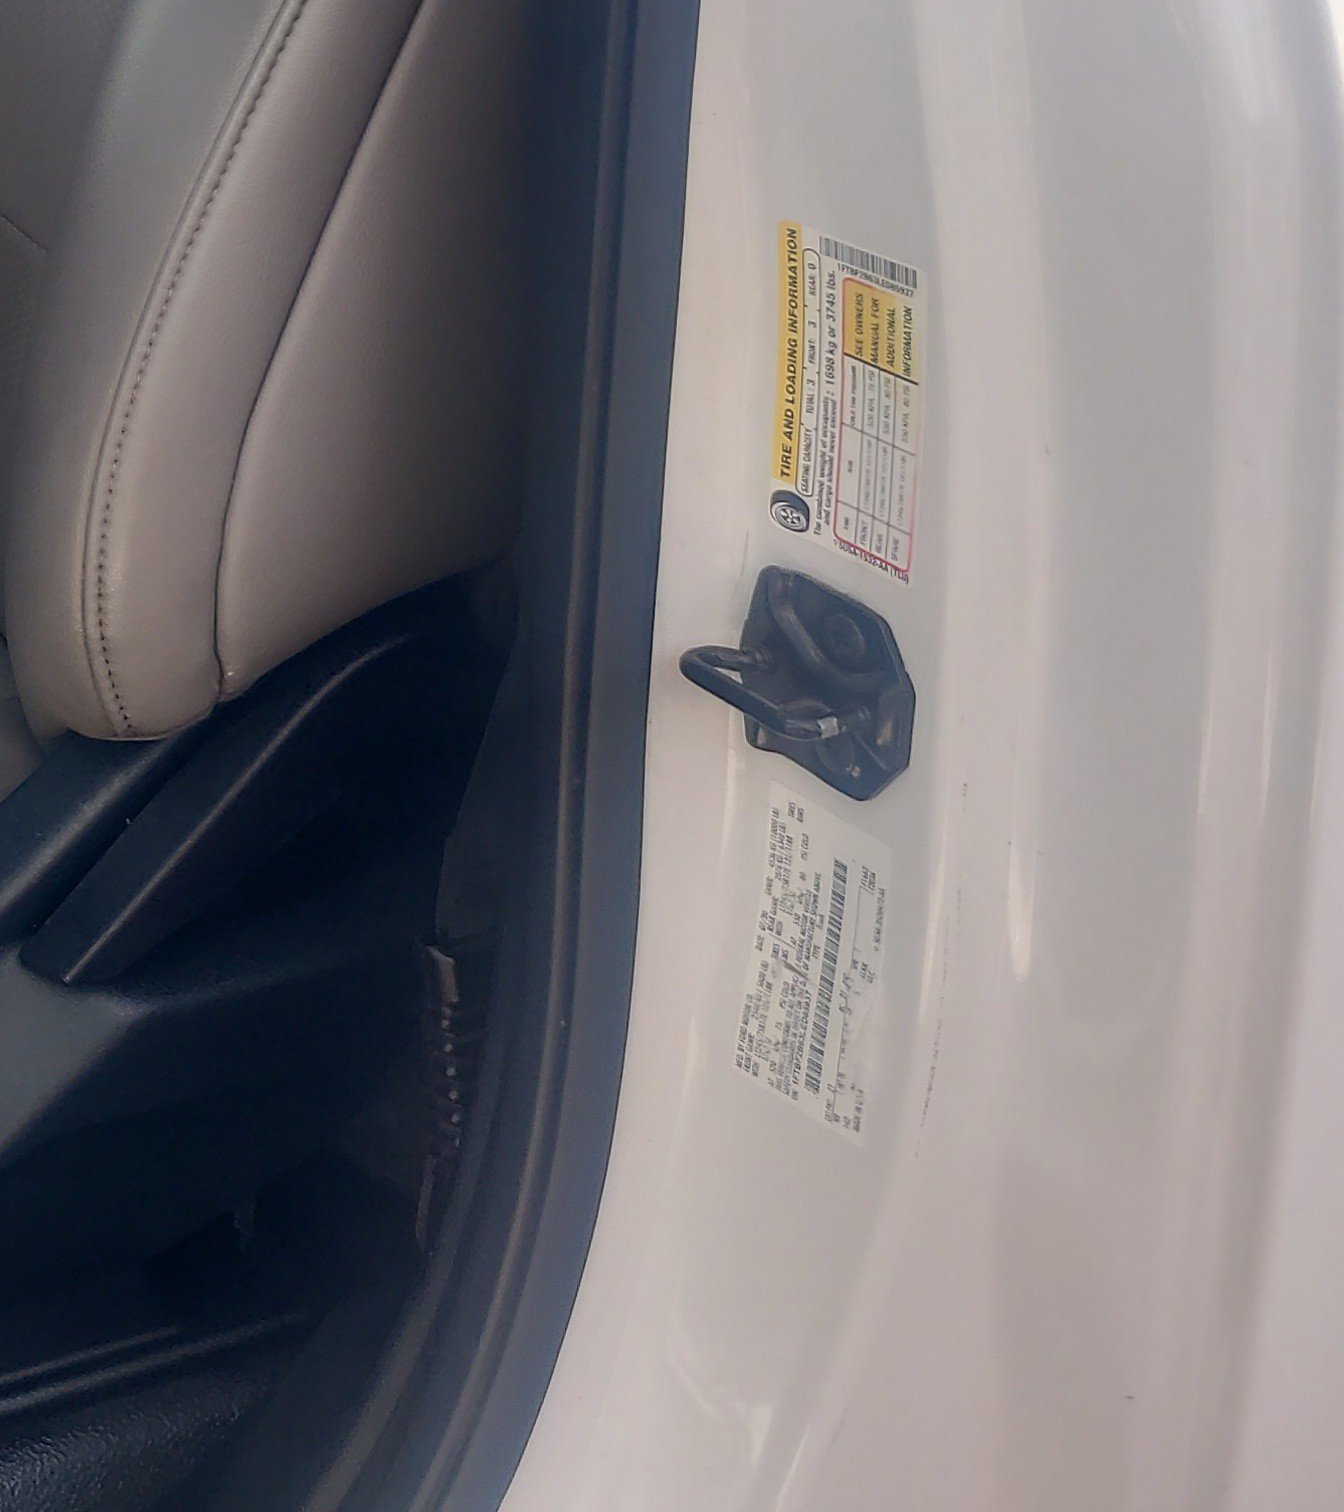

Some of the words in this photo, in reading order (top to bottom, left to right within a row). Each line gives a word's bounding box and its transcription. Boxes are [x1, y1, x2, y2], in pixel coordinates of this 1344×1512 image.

[786, 228, 798, 333] INFORMATION
[826, 293, 836, 322] 3745
[871, 297, 879, 318] FOR
[825, 341, 837, 355] kg
[827, 325, 836, 338] or
[854, 338, 863, 357] SEE
[870, 322, 879, 364] MANUAL
[886, 307, 895, 368] ADDITIONAL
[903, 306, 912, 377] INFORMATION
[784, 338, 798, 404] LOADING
[825, 357, 835, 385] 1698
[783, 408, 794, 441] AND
[780, 444, 792, 478] TIRE
